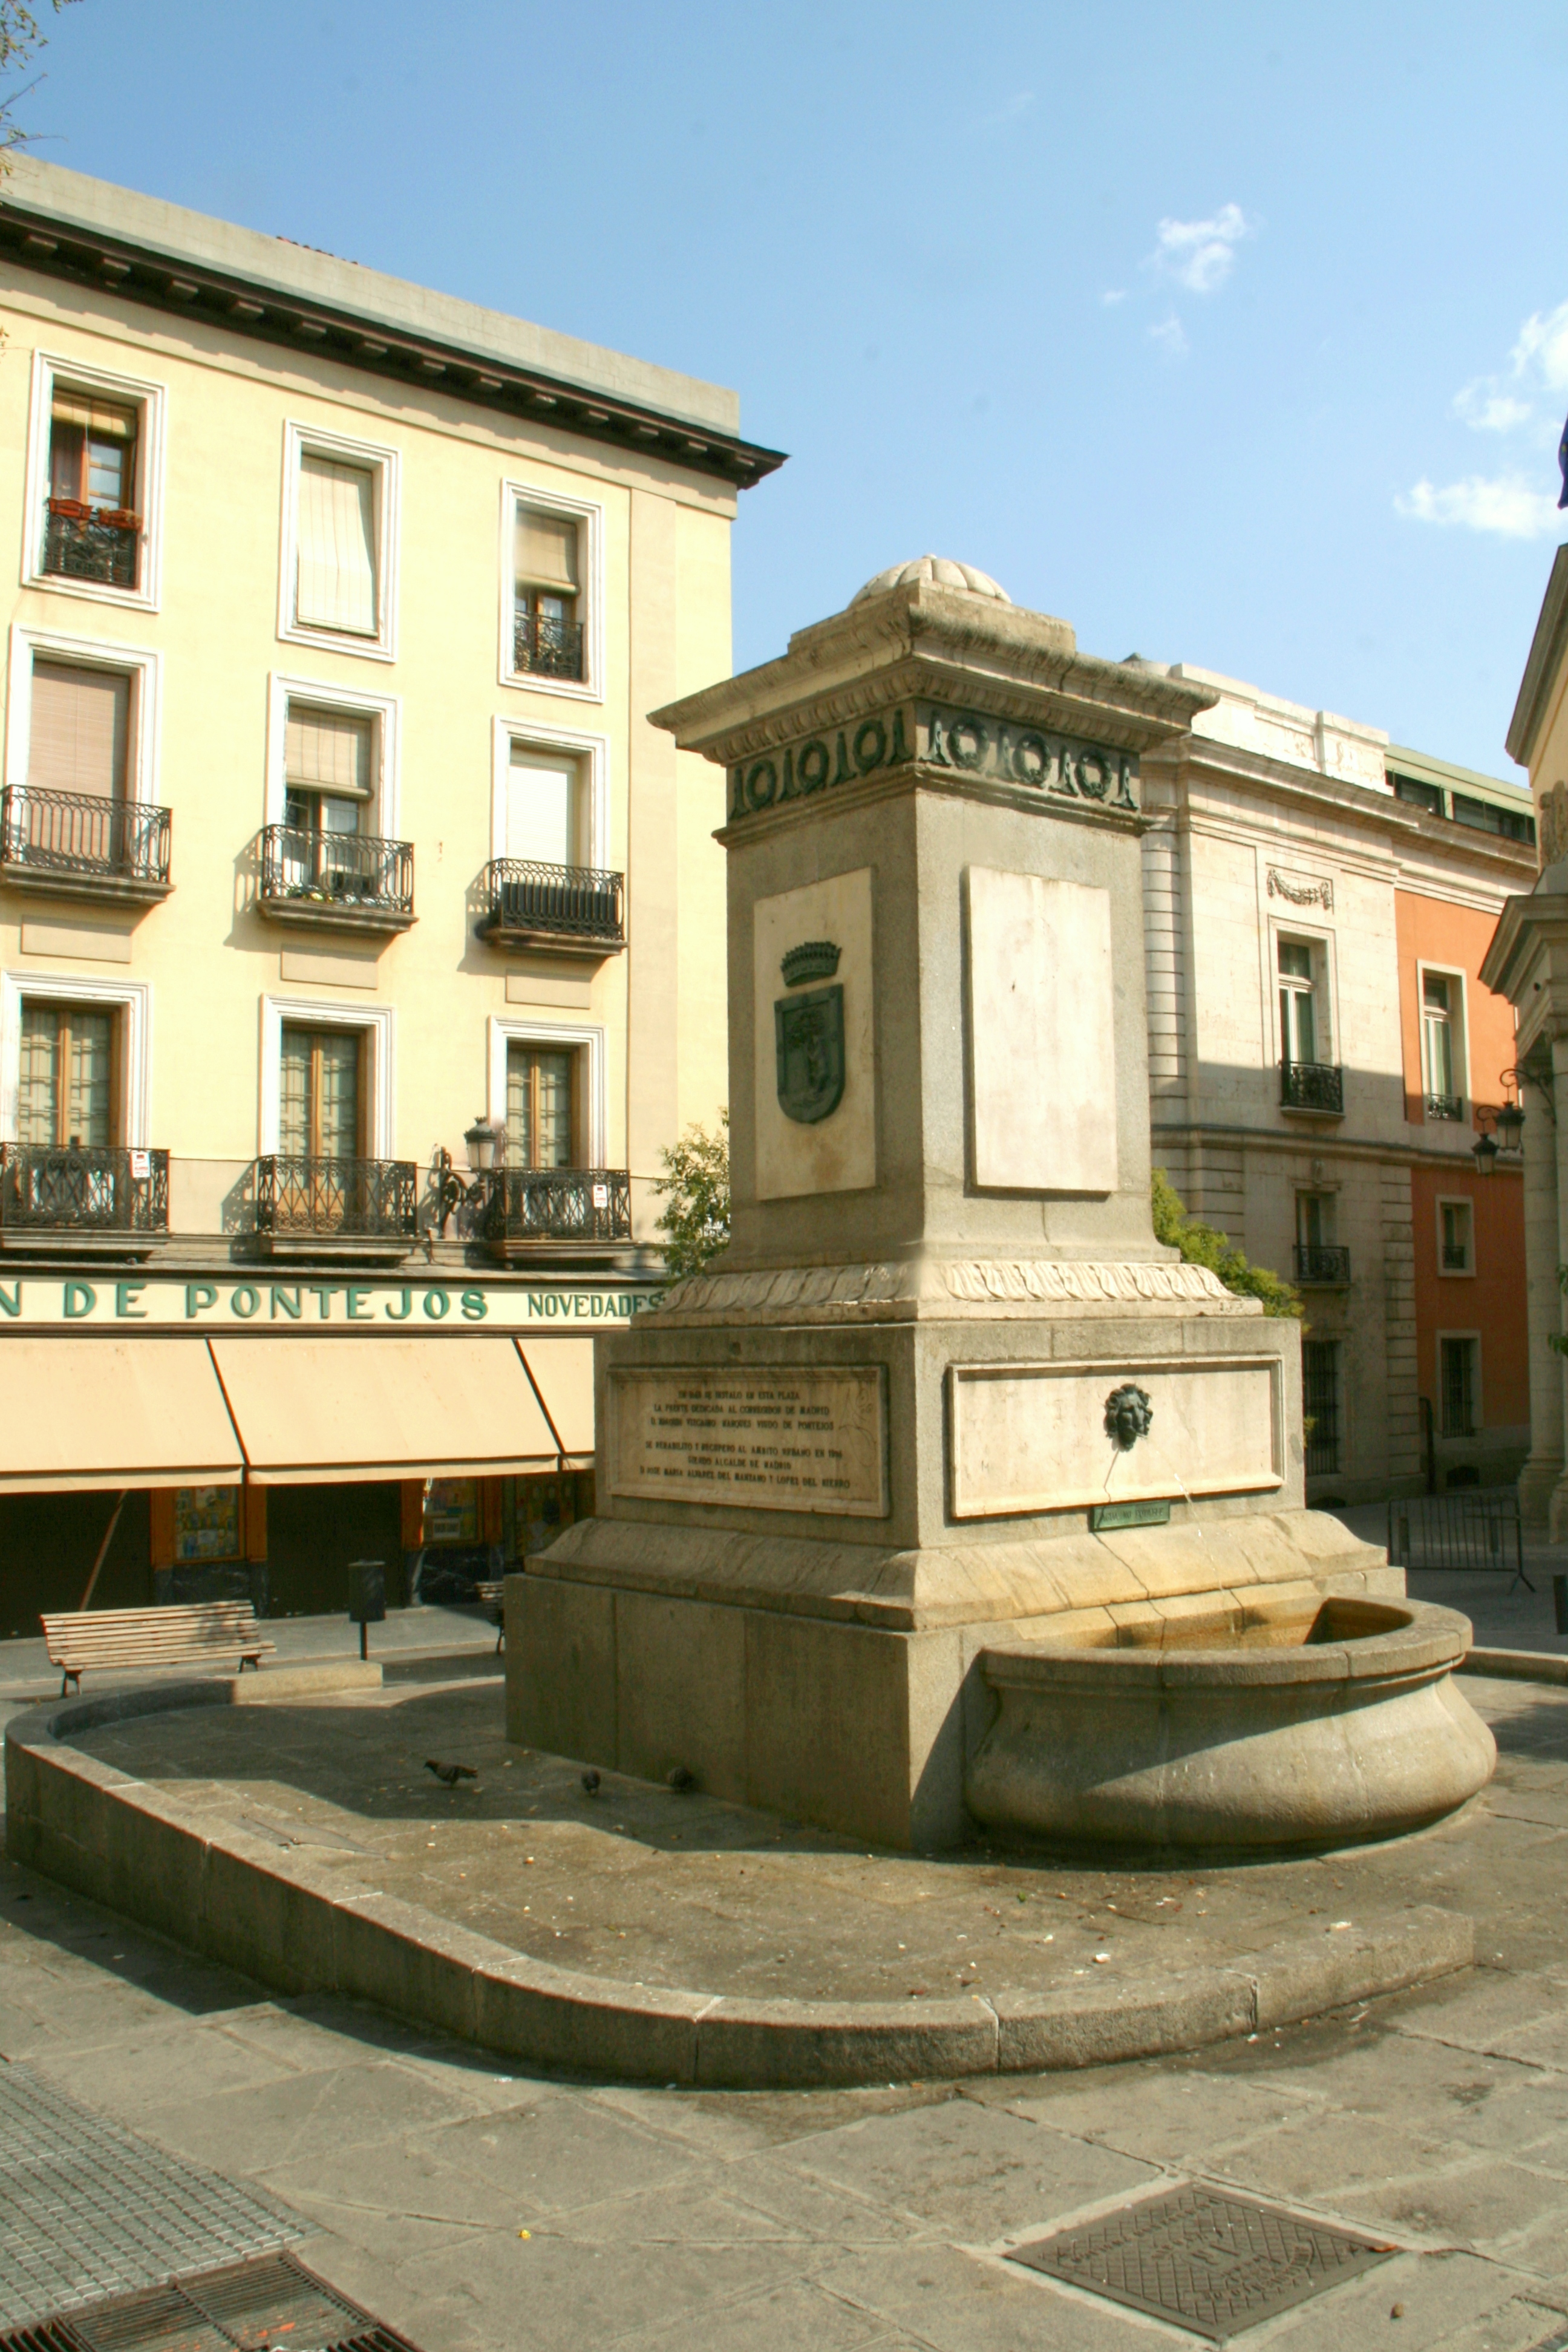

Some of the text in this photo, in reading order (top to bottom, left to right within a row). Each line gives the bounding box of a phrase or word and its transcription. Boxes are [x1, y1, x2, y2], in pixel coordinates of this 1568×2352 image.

[64, 1282, 148, 1318] DE
[185, 1284, 489, 1321] PONTEJOS
[665, 1404, 688, 1413] FUENTE
[800, 1406, 829, 1415] MADRID
[687, 1419, 716, 1427] VIZCAINO
[722, 1420, 751, 1428] MARQUES
[757, 1420, 778, 1429] VIUDO
[798, 1421, 834, 1430] PONTEJOS
[656, 1442, 692, 1451] REHABILITO
[701, 1444, 735, 1452] RECUPERO
[751, 1446, 778, 1455] AMBITO
[782, 1448, 811, 1457] URBANO
[815, 1449, 825, 1457] EN
[688, 1455, 712, 1465] SIENDO
[715, 1458, 746, 1467] ALCALDE
[764, 1461, 791, 1470] MADRID
[664, 1468, 683, 1476] MARIA
[688, 1470, 714, 1479] ALVAREZ
[717, 1471, 730, 1480] DEL
[734, 1472, 766, 1483] MANZANO
[769, 1474, 773, 1483] Y
[777, 1475, 799, 1485] LOPEZ
[803, 1477, 817, 1486] DEL
[822, 1478, 850, 1488] HIERRO
